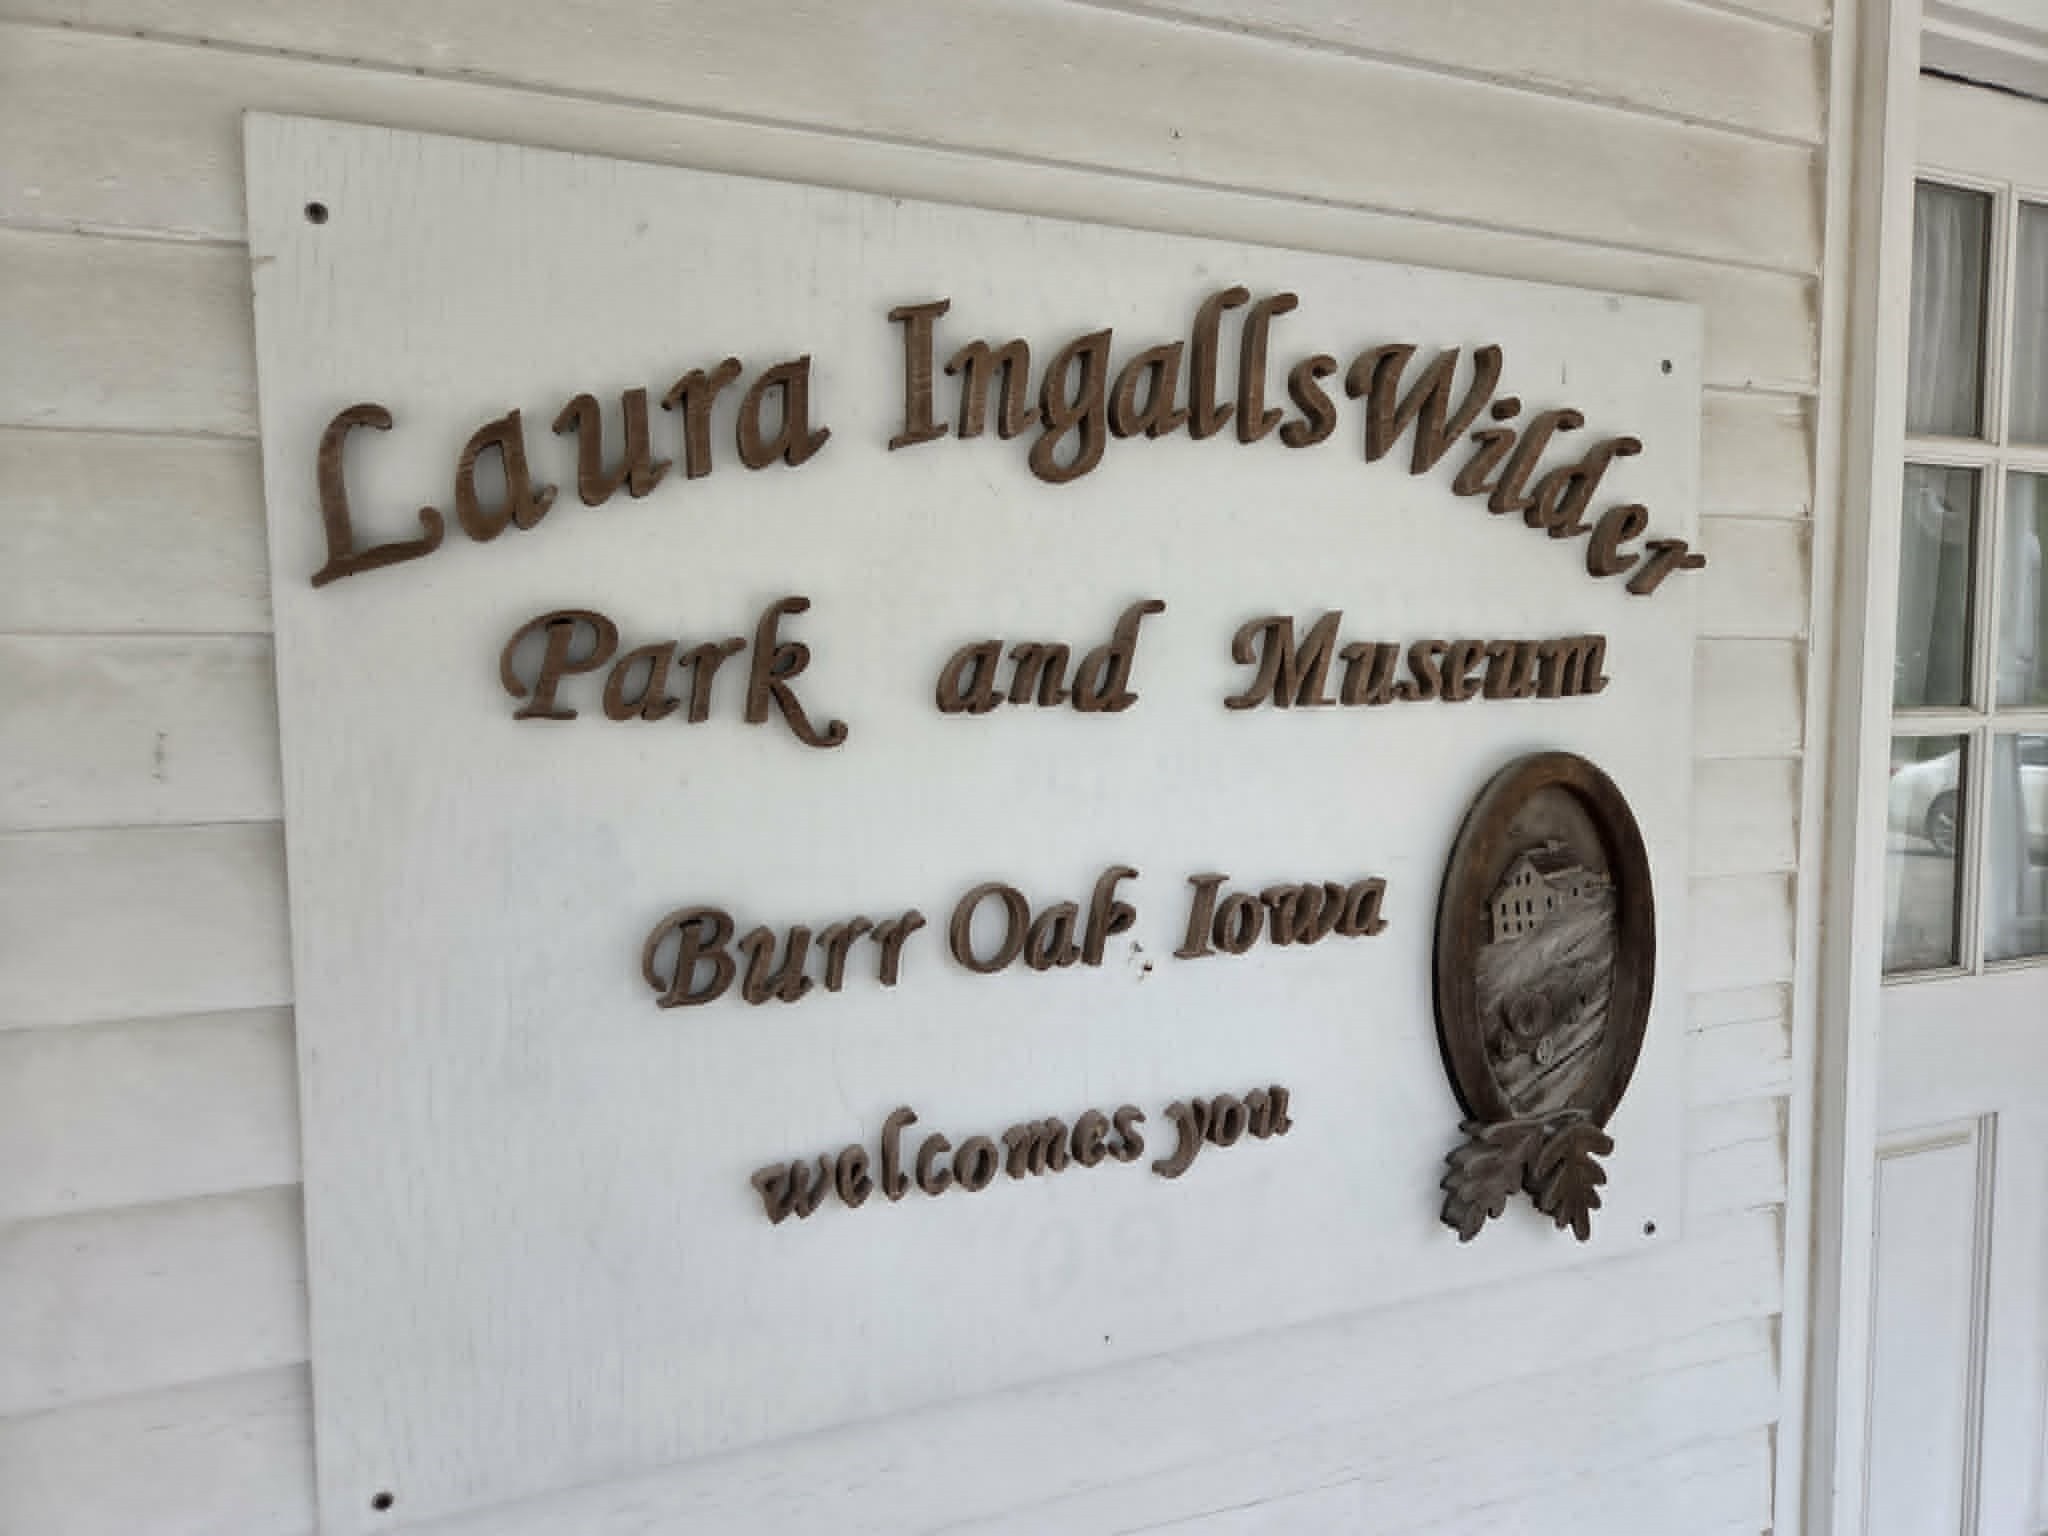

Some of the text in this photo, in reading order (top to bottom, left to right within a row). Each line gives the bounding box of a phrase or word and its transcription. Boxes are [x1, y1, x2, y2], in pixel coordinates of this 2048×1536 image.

[308, 285, 1708, 597] Laura Ingalls Wilder
[498, 595, 1611, 749] Park and Museum
[641, 905, 928, 1009] Burr
[1172, 872, 1389, 961] Iowa
[750, 1084, 1294, 1226] welcomes you
